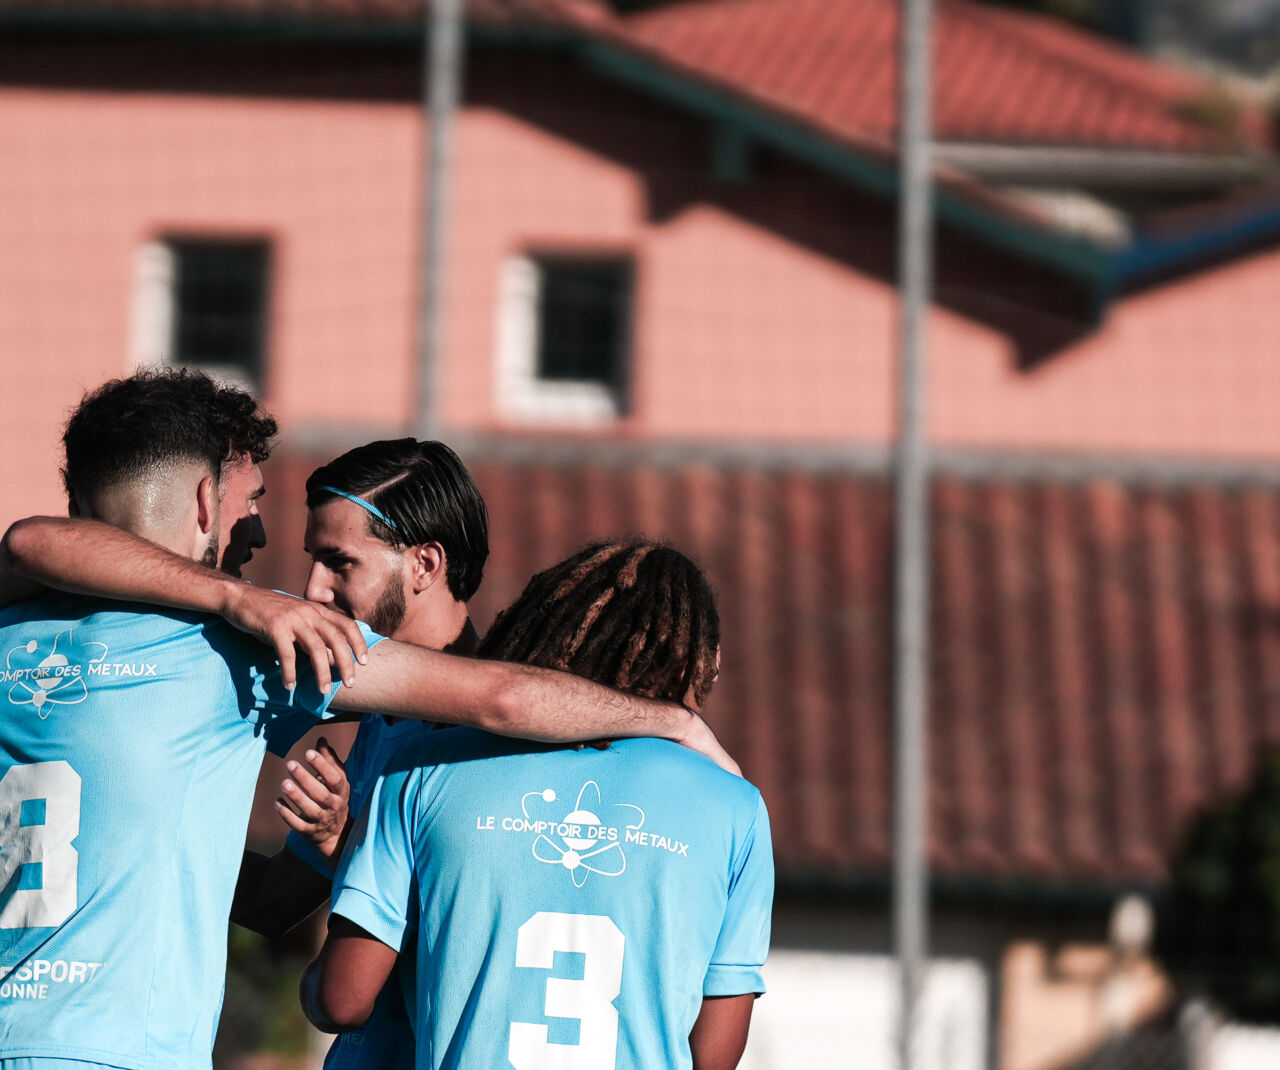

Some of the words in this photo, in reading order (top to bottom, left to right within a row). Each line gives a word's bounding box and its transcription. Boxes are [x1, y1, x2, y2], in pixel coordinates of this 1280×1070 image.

[54, 664, 82, 678] DES
[476, 816, 496, 830] LE
[502, 817, 582, 838] COMPTOIR
[587, 827, 619, 841] DES
[624, 829, 691, 858] METAUX
